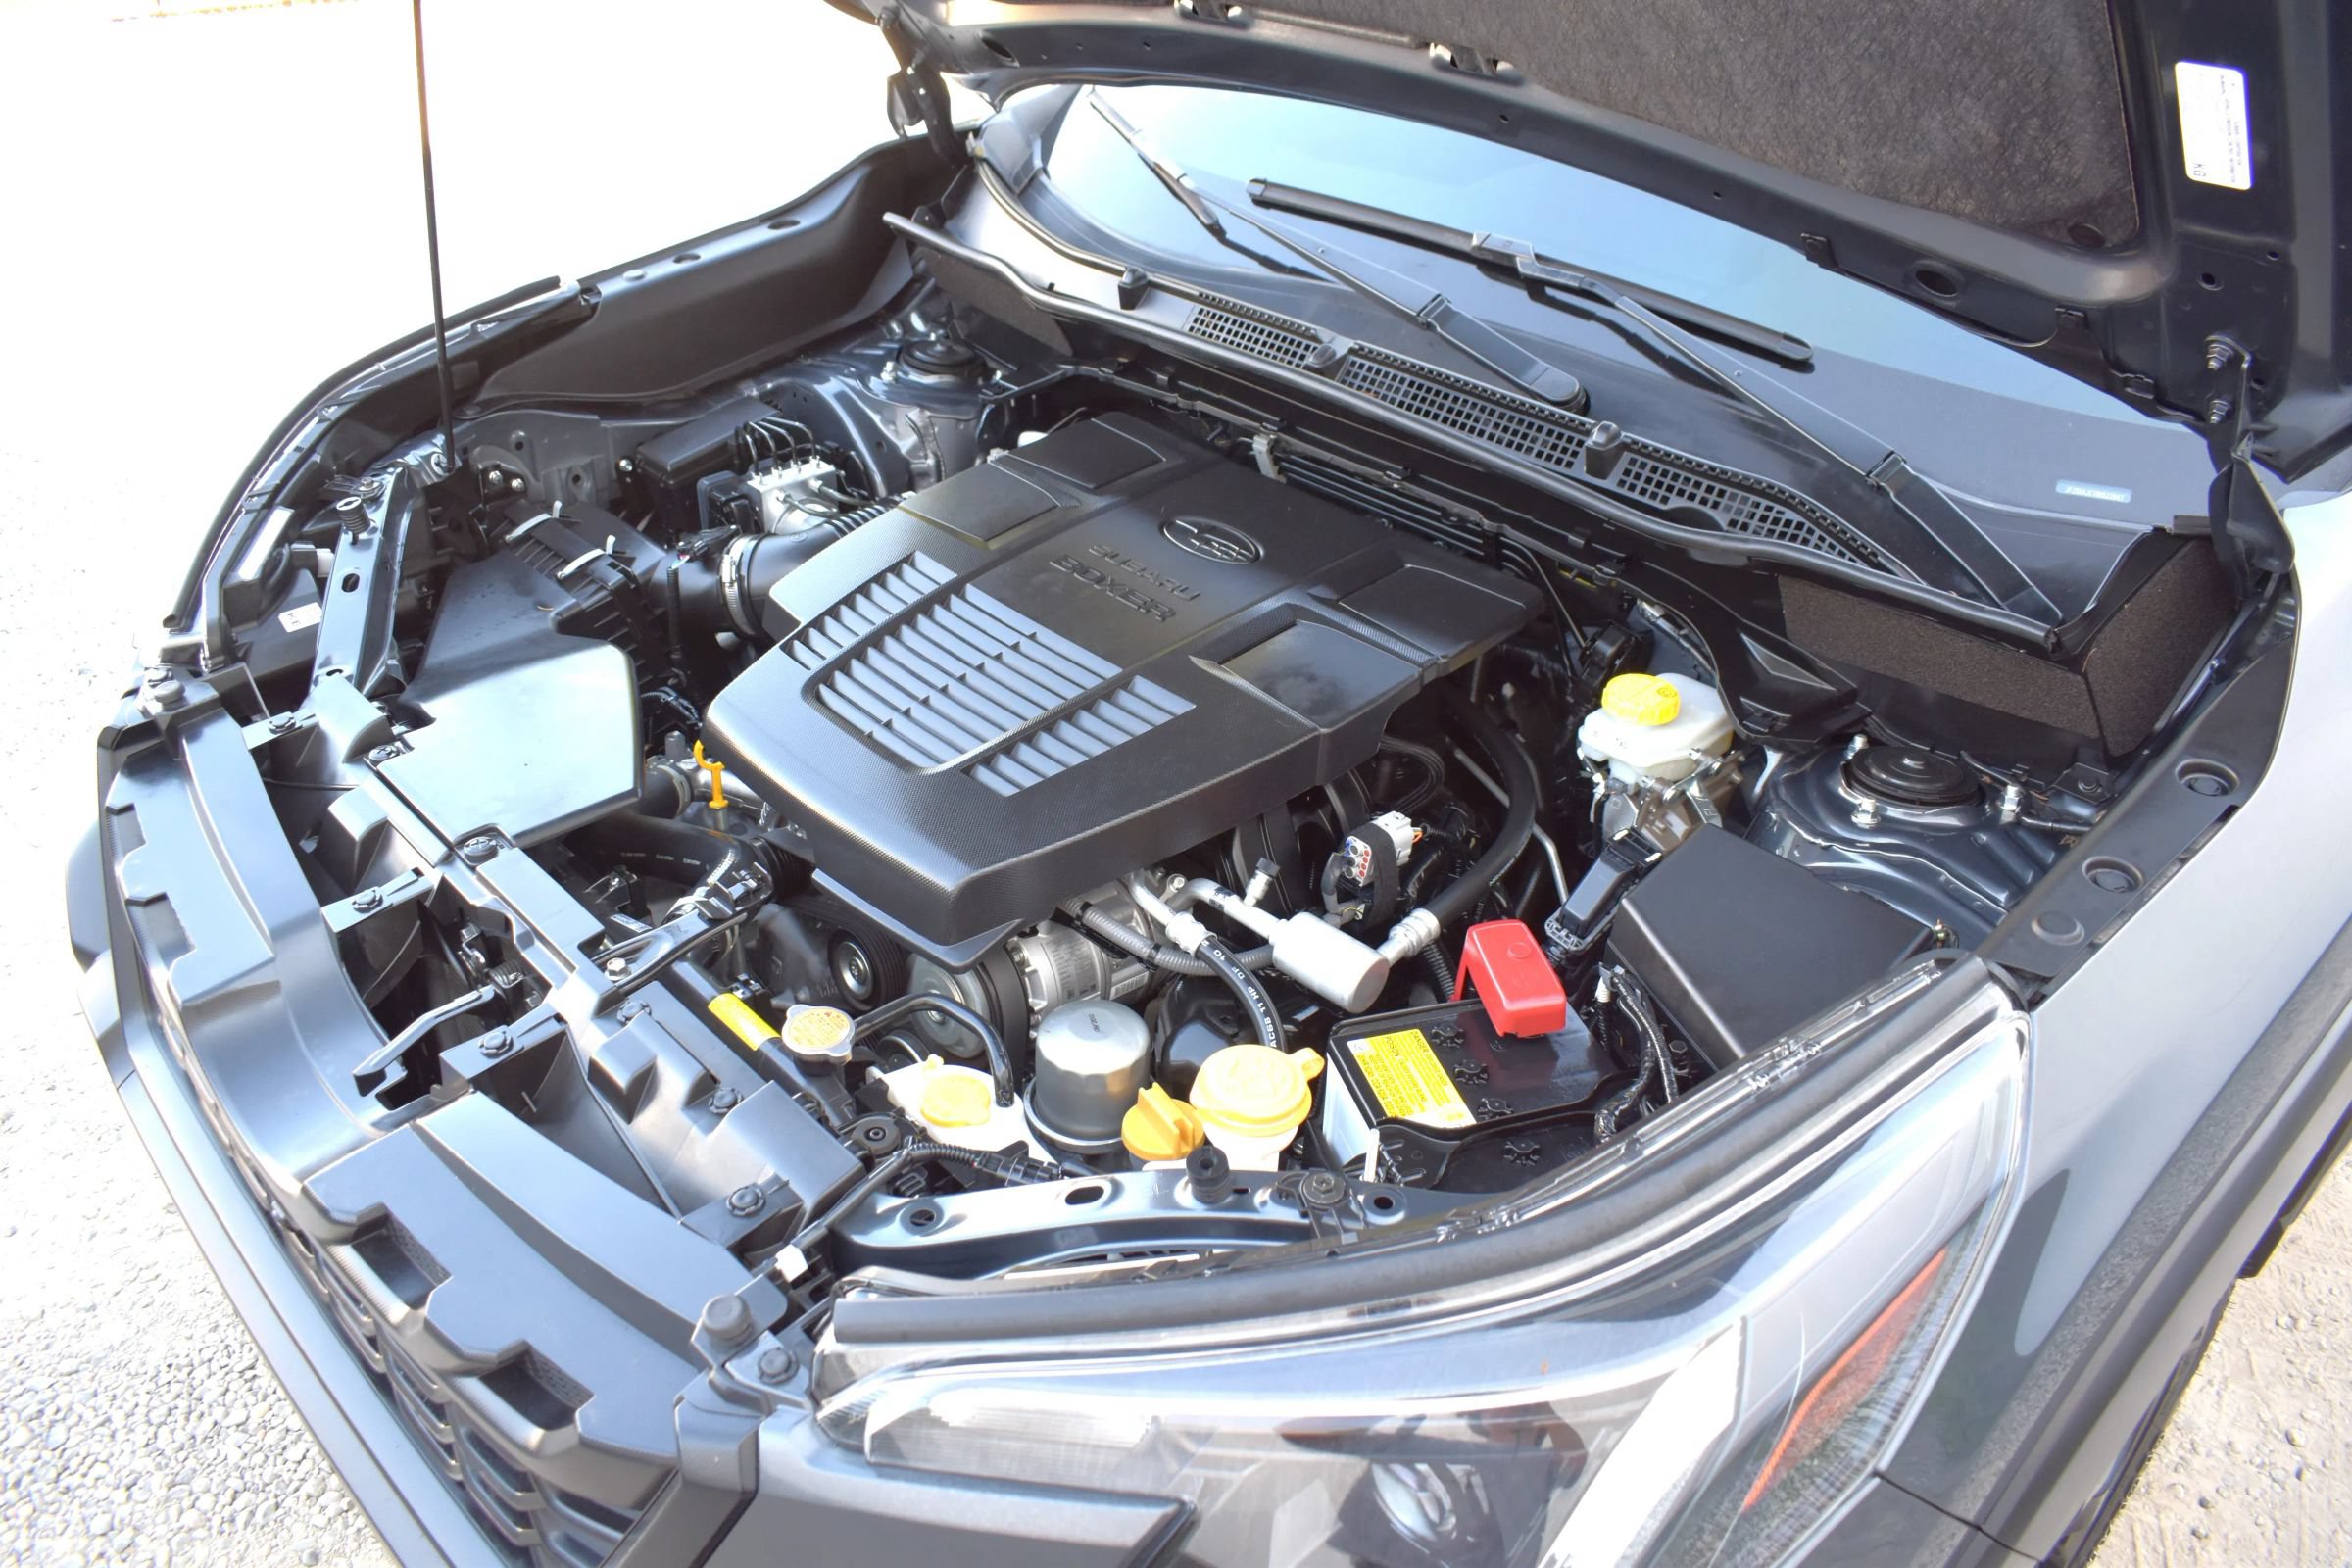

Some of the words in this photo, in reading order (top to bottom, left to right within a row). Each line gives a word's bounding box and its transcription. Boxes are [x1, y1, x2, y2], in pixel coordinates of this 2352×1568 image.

[1089, 544, 1201, 601] SUBARU
[1049, 554, 1176, 622] BOXER
[1232, 966, 1245, 980] DF
[1248, 986, 1259, 999] HP
[1385, 1035, 1400, 1057] POISON
[1411, 1031, 1429, 1053] DANGER
